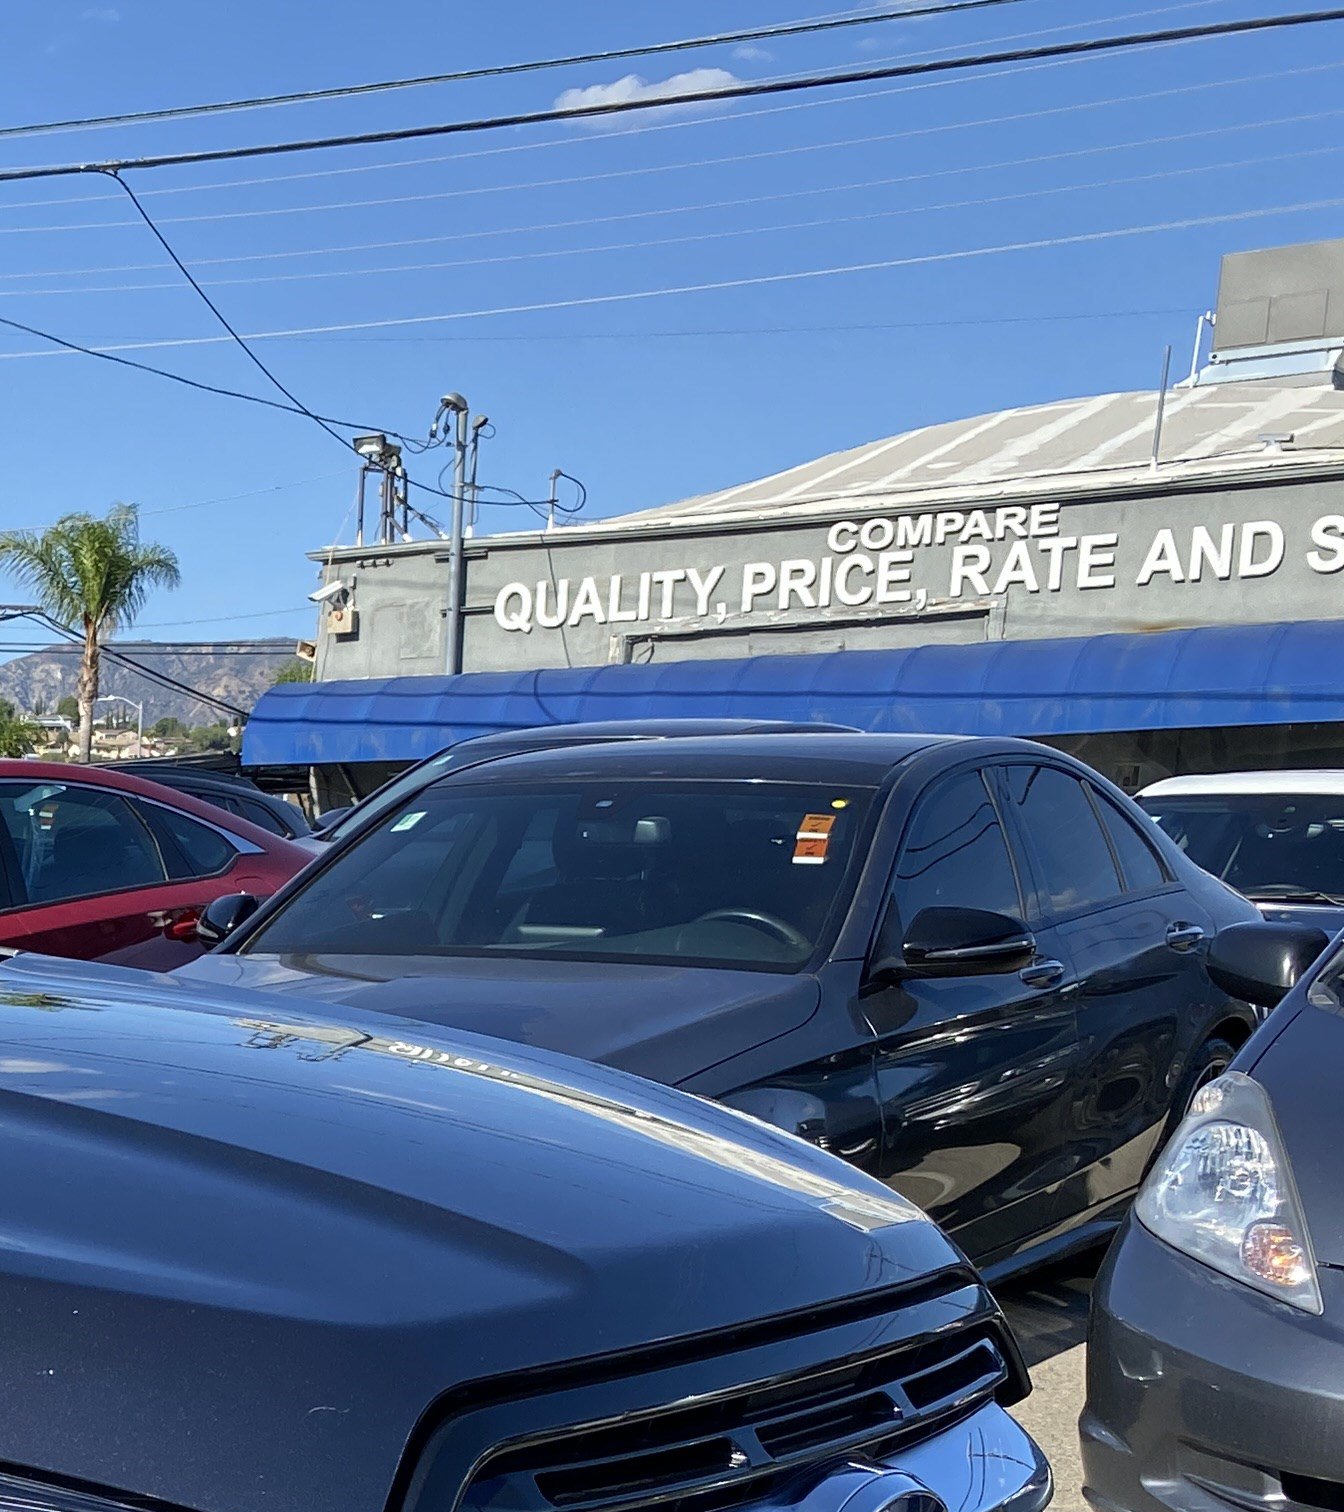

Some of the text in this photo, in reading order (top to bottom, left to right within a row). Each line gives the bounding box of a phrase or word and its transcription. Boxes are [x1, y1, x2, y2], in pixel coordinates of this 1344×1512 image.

[827, 503, 1061, 553] COMPARE
[494, 565, 728, 632] QUALITY,
[741, 552, 928, 612] PRICE,
[949, 532, 1118, 597] RATE
[1135, 519, 1286, 587] AND
